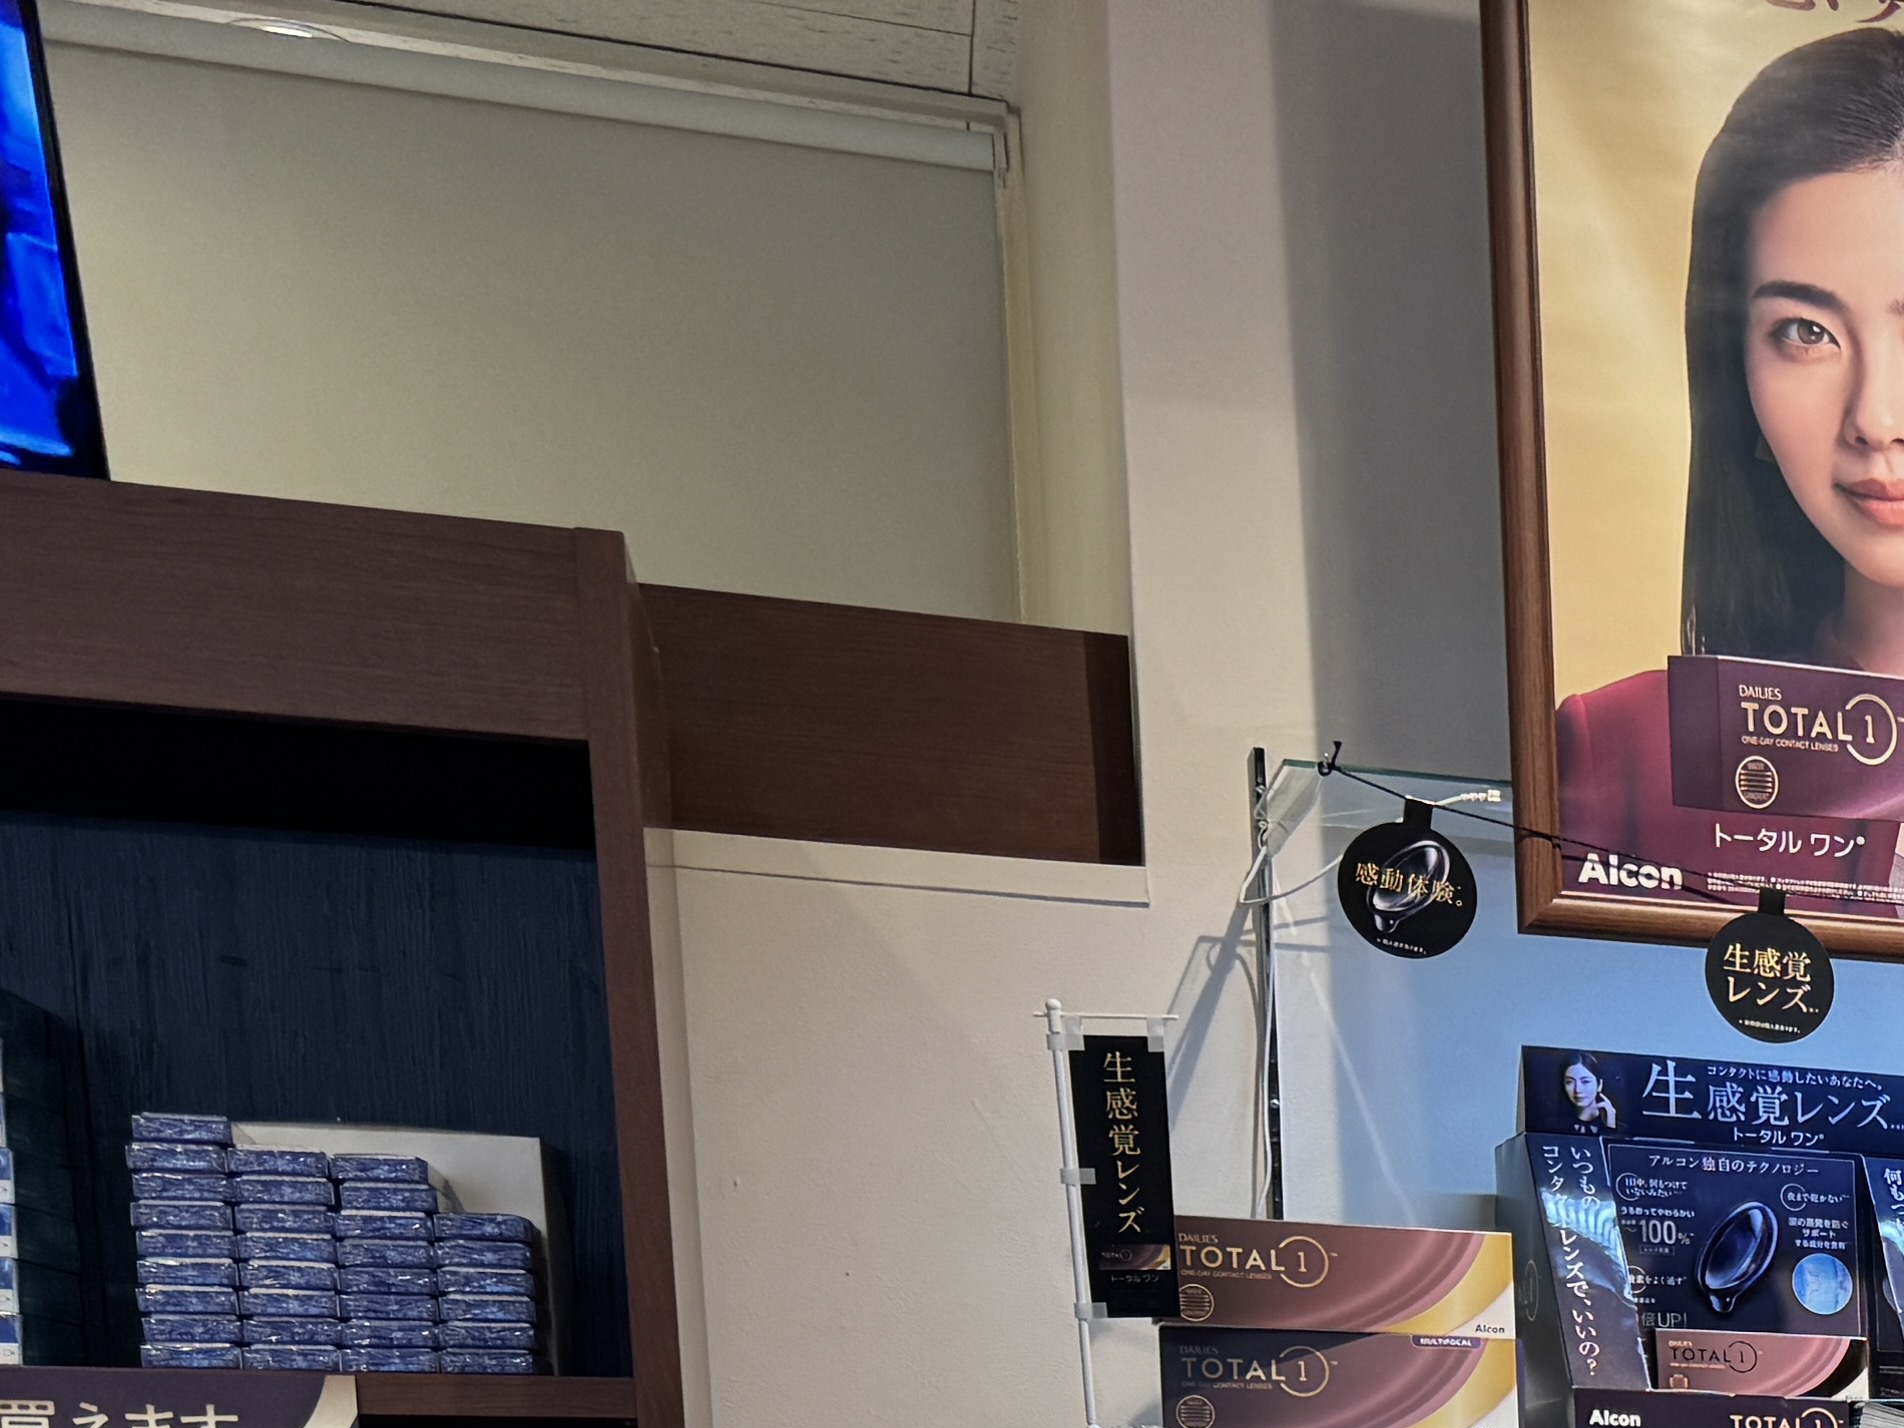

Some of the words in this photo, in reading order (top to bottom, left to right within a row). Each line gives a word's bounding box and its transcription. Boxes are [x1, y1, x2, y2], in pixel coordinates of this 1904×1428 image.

[1739, 685, 1783, 702] DAILIES
[1713, 823, 1802, 854] トータル
[1354, 861, 1465, 908] 感動体験。
[1577, 852, 1683, 891] Alcon
[1721, 943, 1812, 983] 生感覚
[1726, 976, 1809, 1013] レンズ
[1706, 1064, 1884, 1091] コンタクトに感動したいあなたへ。
[1640, 1058, 1893, 1132] 生感覚レンズ
[1101, 1050, 1146, 1236] 生感覚レンズ
[1732, 1128, 1788, 1145] トータル
[1569, 1146, 1601, 1211] いつもの
[1648, 1153, 1820, 1177] アルコン独自のテクノロジー
[1475, 1323, 1506, 1335] Alcon
[1588, 1408, 1642, 1428] Alcon
